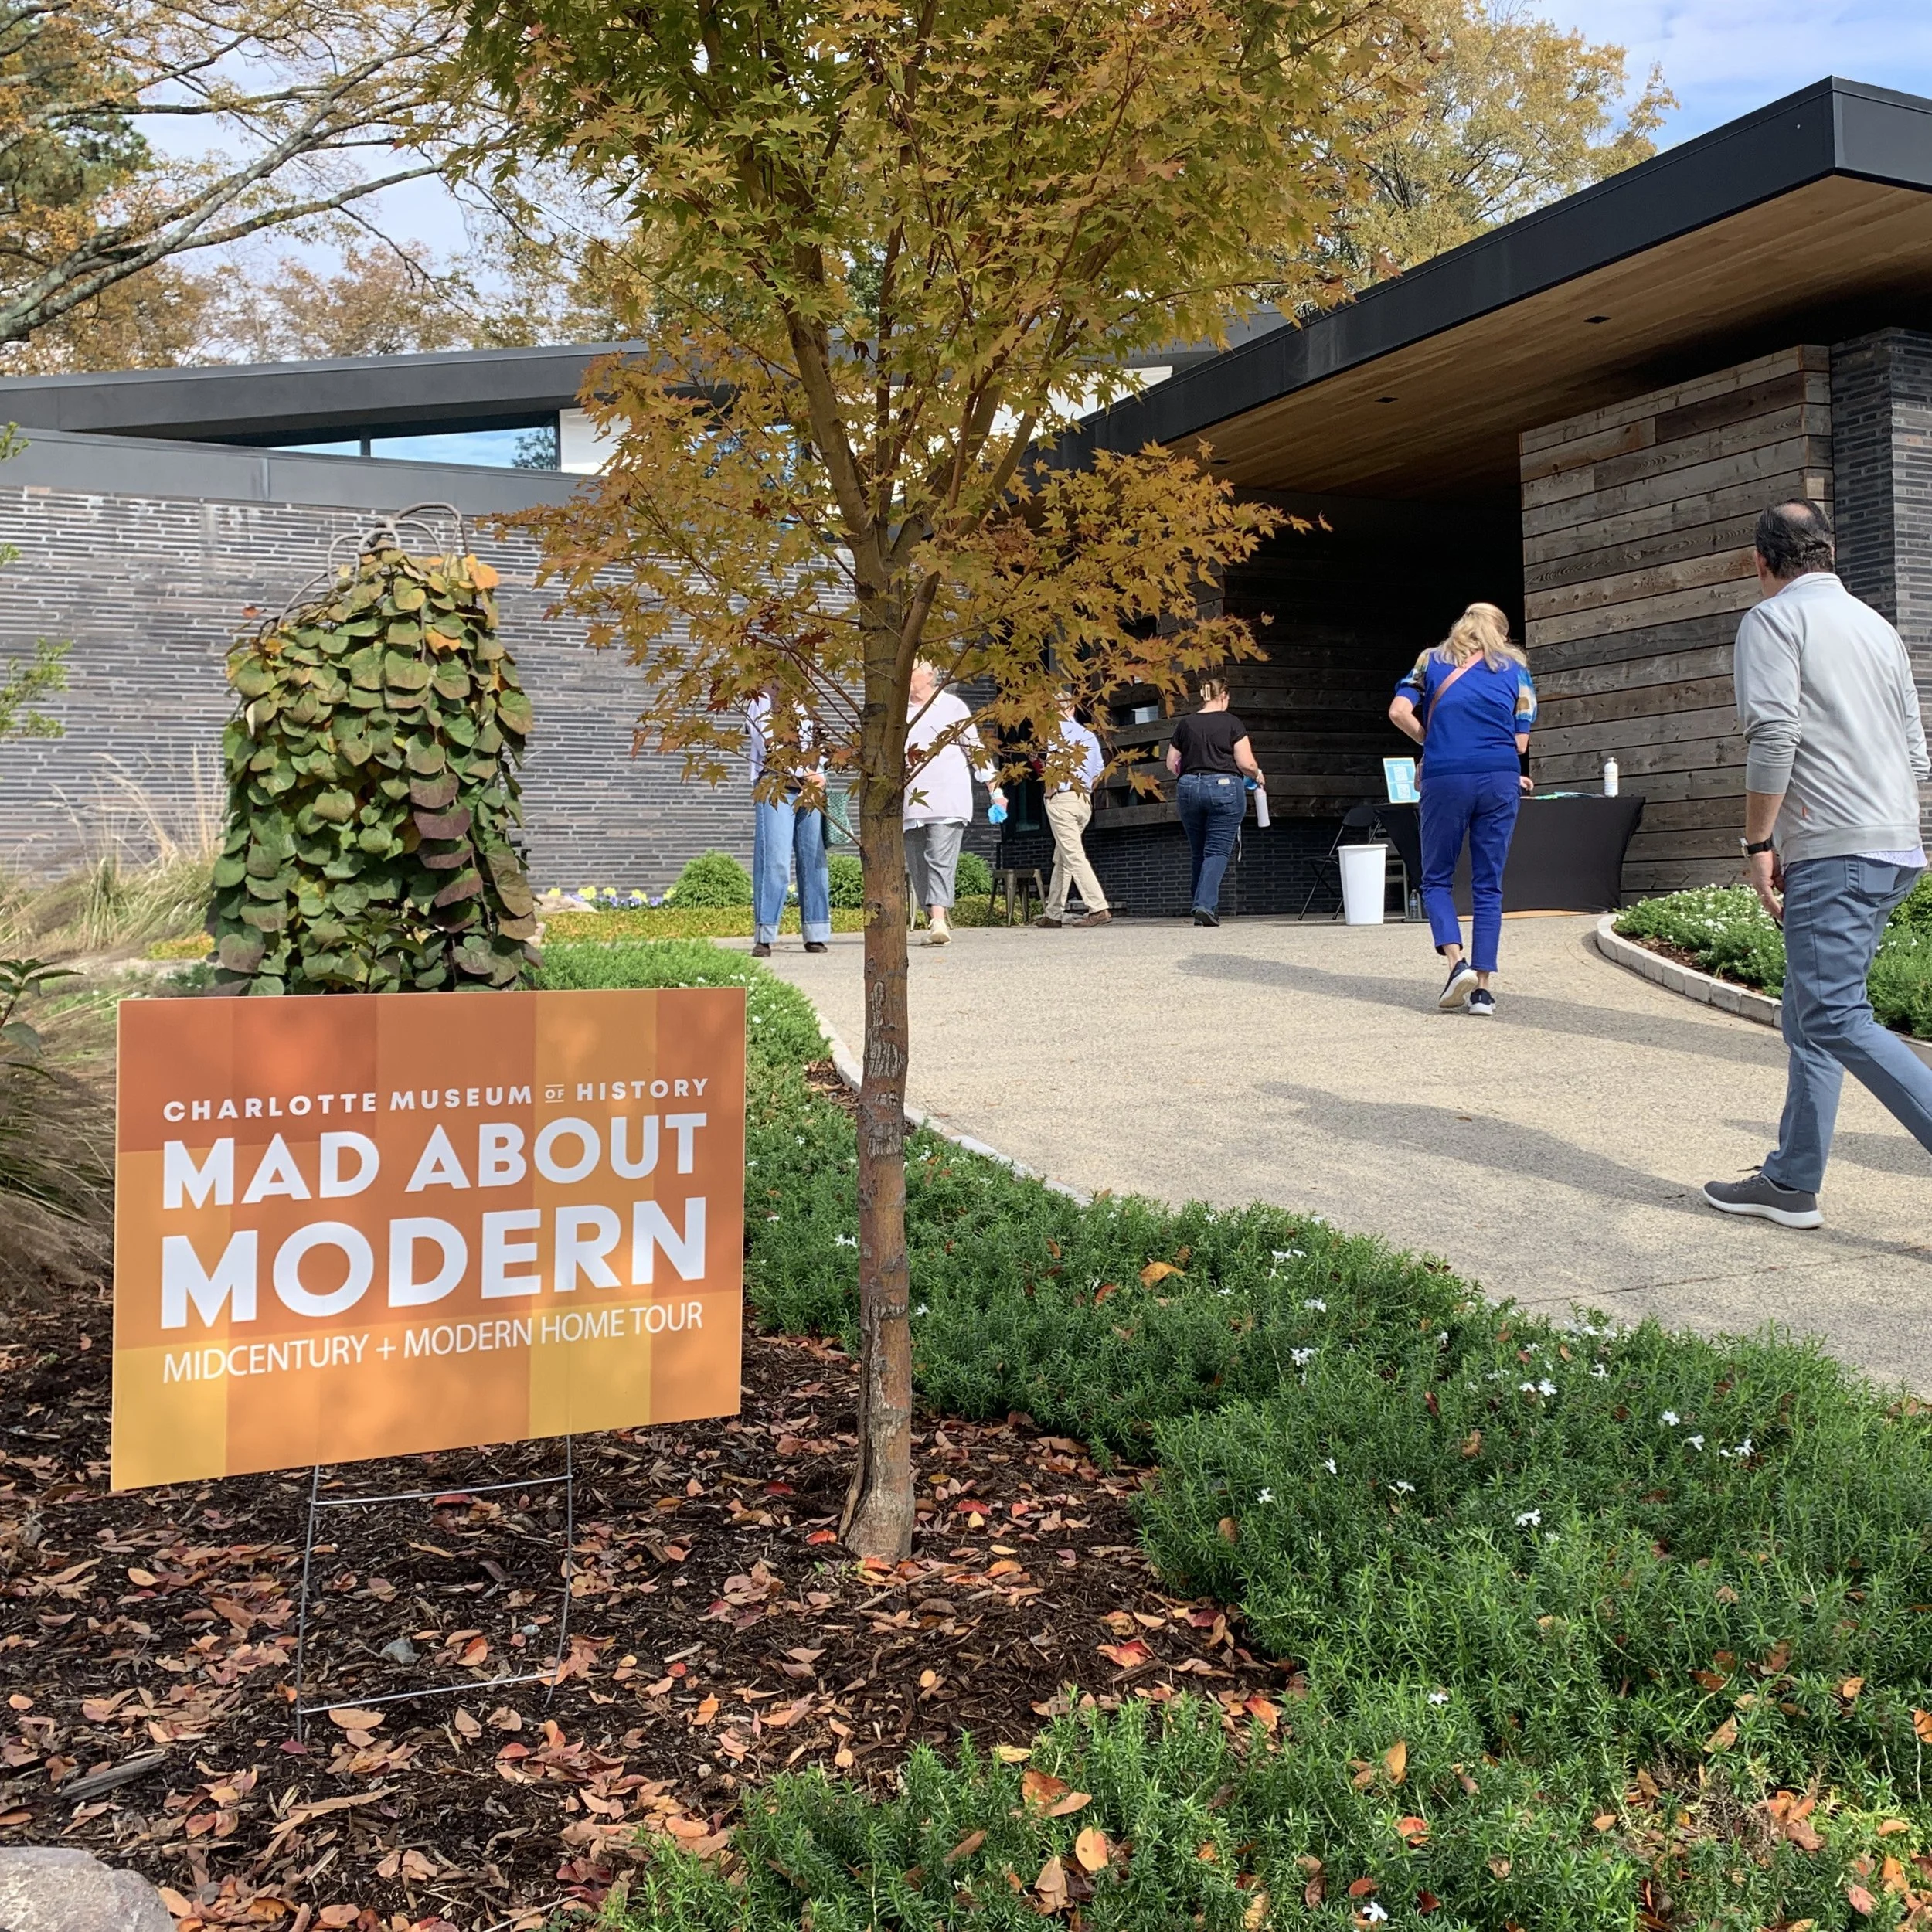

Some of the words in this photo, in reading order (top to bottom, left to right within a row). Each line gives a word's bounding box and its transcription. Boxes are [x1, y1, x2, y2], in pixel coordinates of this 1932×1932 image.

[163, 1092, 376, 1122] CHARLOTTE
[389, 1086, 532, 1111] MUSEUM
[545, 1089, 565, 1100] OF
[577, 1078, 709, 1101] HISTORY
[162, 1131, 381, 1209] MAD
[404, 1112, 708, 1192] ABOUT
[160, 1196, 707, 1329] MODERN
[162, 1332, 370, 1384] MIDCENTURY
[376, 1337, 396, 1361] +
[403, 1318, 532, 1359] MODERN
[540, 1307, 625, 1345] HOME
[629, 1301, 703, 1335] TOUR
